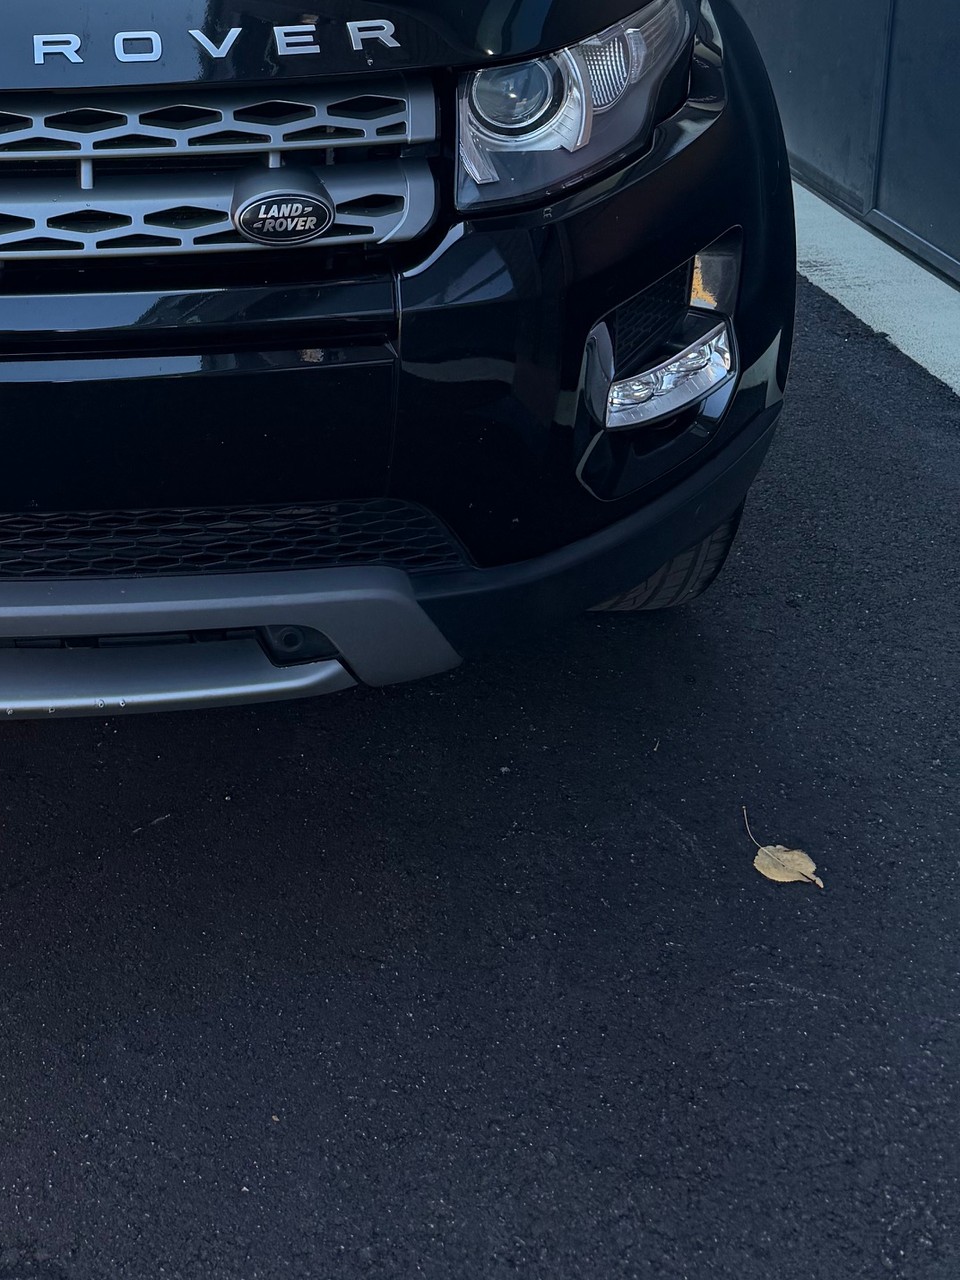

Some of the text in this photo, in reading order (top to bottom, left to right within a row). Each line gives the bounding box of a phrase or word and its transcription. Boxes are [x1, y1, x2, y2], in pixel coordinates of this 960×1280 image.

[33, 19, 401, 64] ROVER
[258, 203, 303, 219] LAND
[263, 216, 317, 232] ROVER
